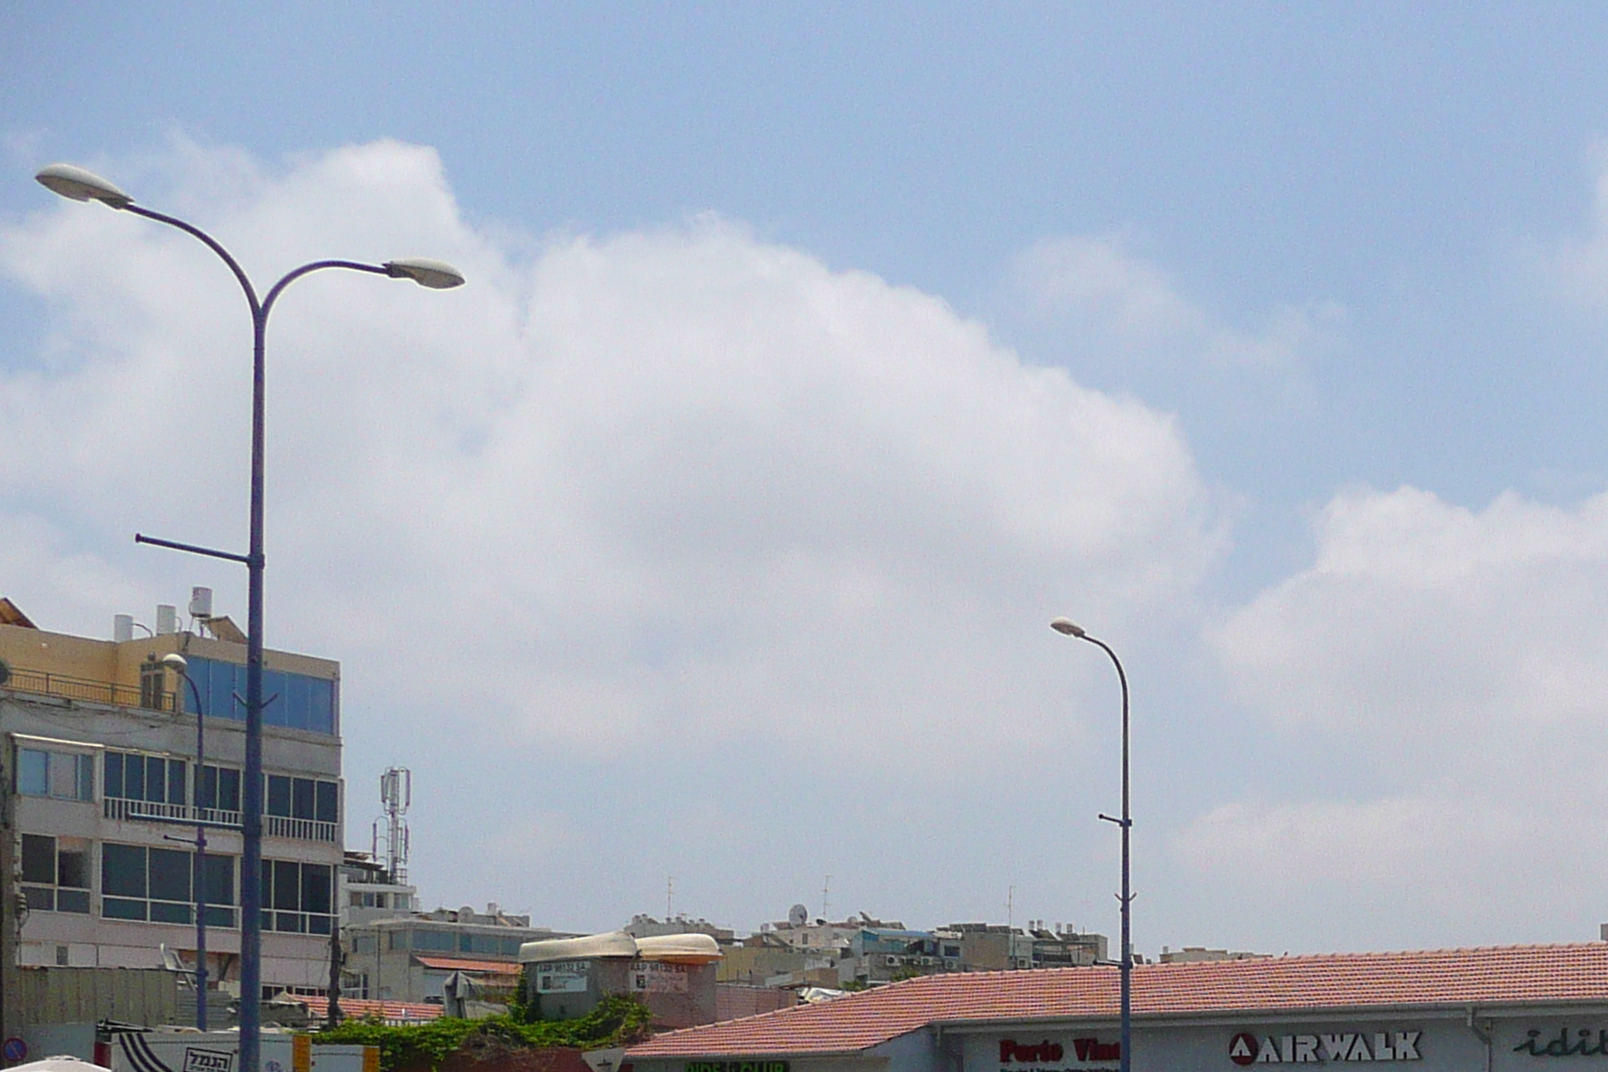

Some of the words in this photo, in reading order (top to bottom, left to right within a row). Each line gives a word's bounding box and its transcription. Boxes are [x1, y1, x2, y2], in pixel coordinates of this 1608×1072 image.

[1000, 1039, 1063, 1062] Porto
[1256, 1032, 1422, 1063] AIRWALK
[190, 1051, 228, 1069] הנמל
